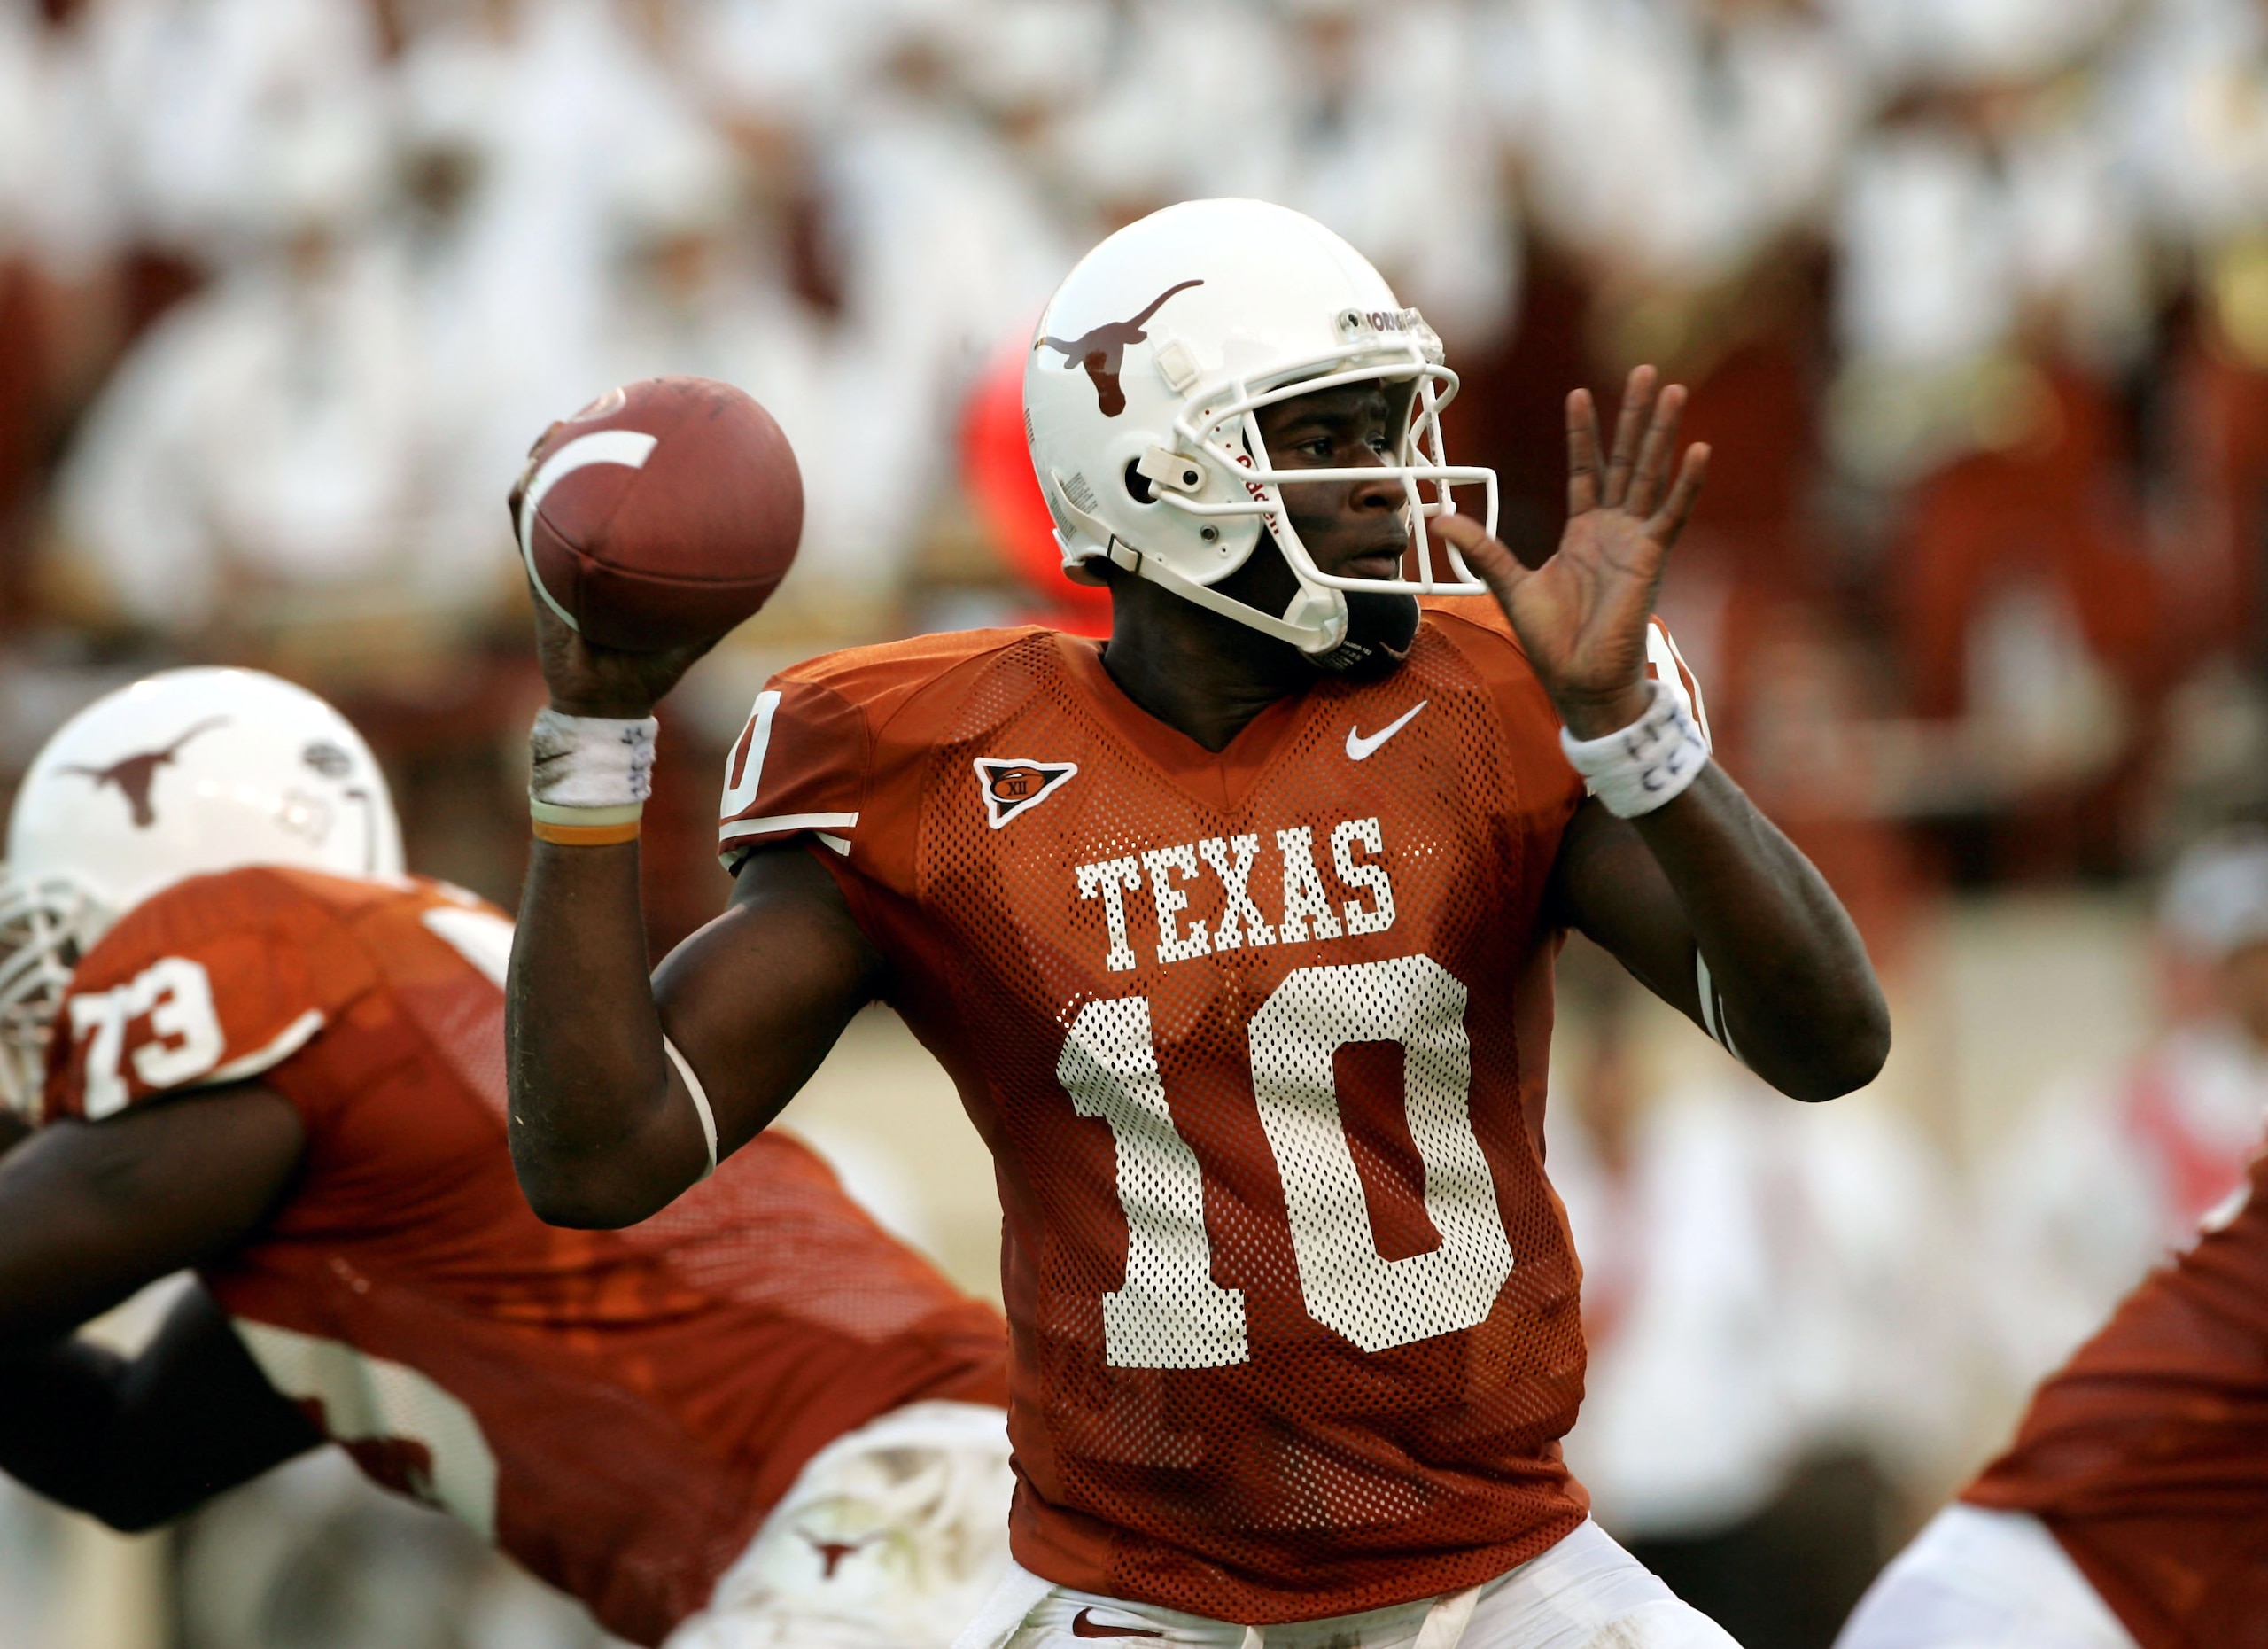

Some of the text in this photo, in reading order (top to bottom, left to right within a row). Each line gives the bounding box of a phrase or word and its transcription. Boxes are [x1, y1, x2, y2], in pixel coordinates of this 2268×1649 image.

[1006, 781, 1029, 796] XII
[1075, 816, 1396, 972] TEXAS
[68, 955, 228, 1122] 73
[1055, 953, 1515, 1370] 10
